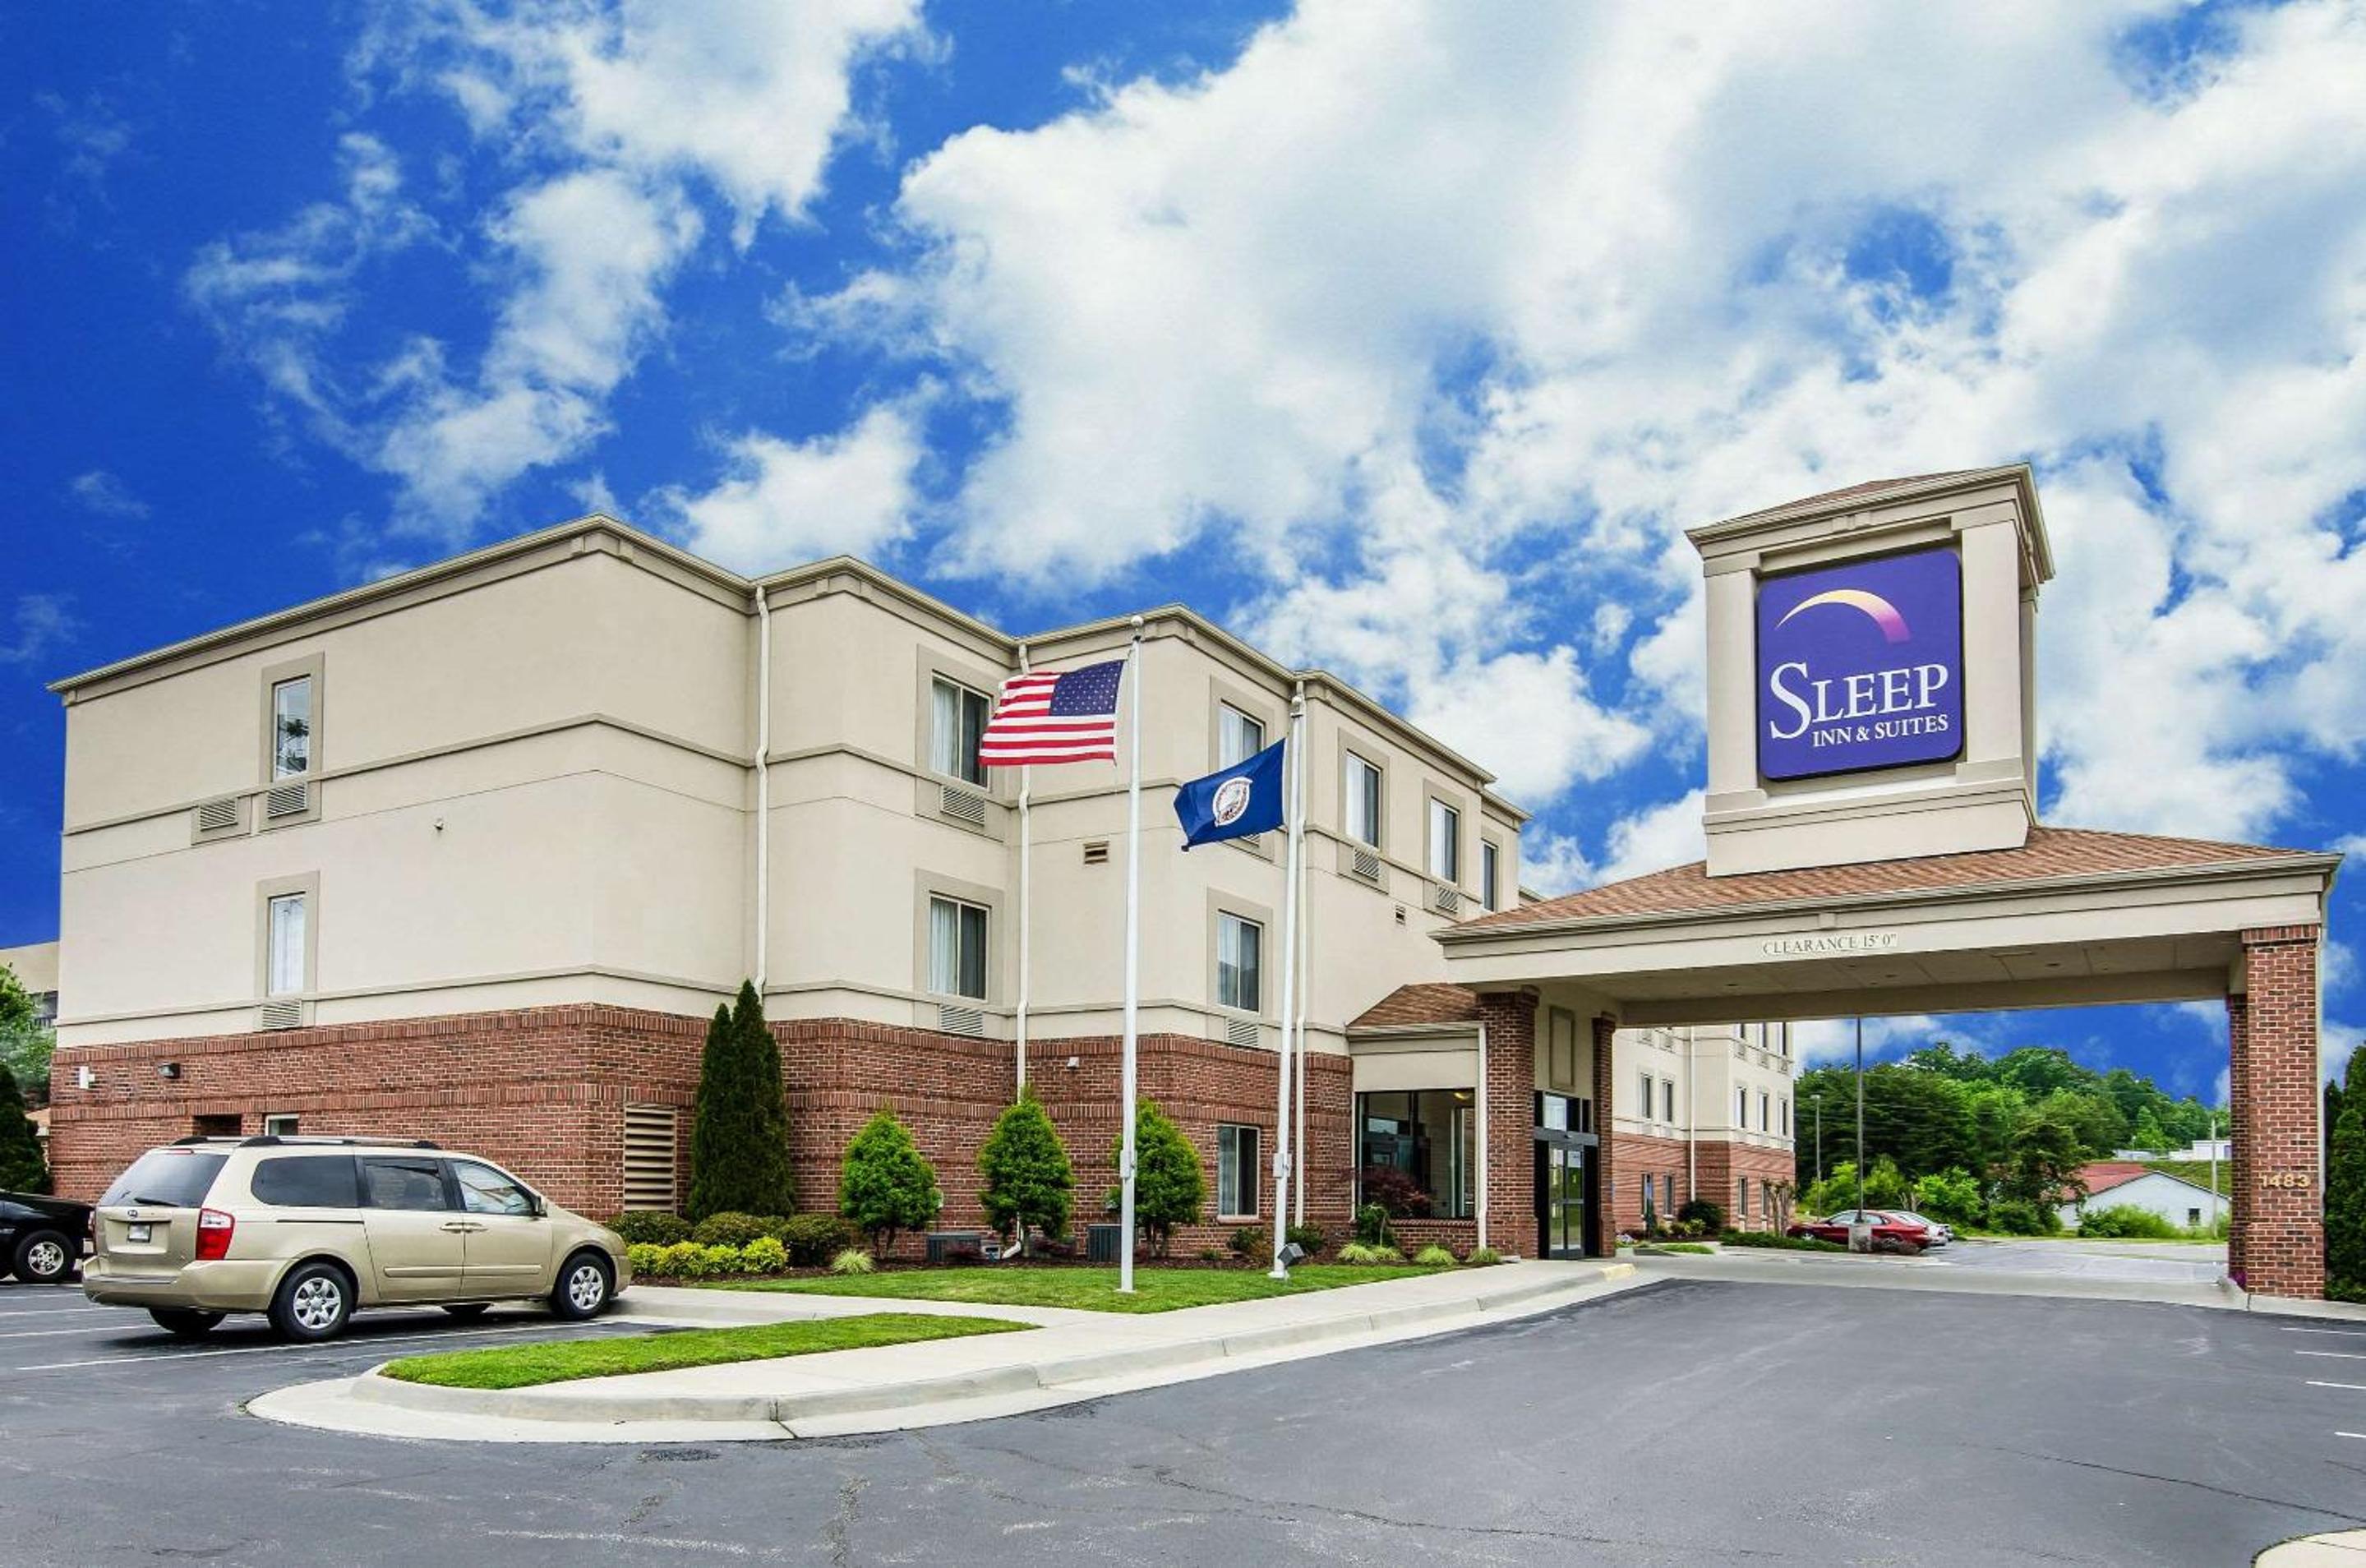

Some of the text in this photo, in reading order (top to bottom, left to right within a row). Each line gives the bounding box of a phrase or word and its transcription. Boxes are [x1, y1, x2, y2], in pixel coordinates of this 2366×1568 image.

[1769, 662, 1949, 740] SLEEP
[1813, 714, 1949, 747] INN & SUITES
[1763, 935, 1858, 955] CLEARANCE
[2259, 1174, 2311, 1188] 1483
